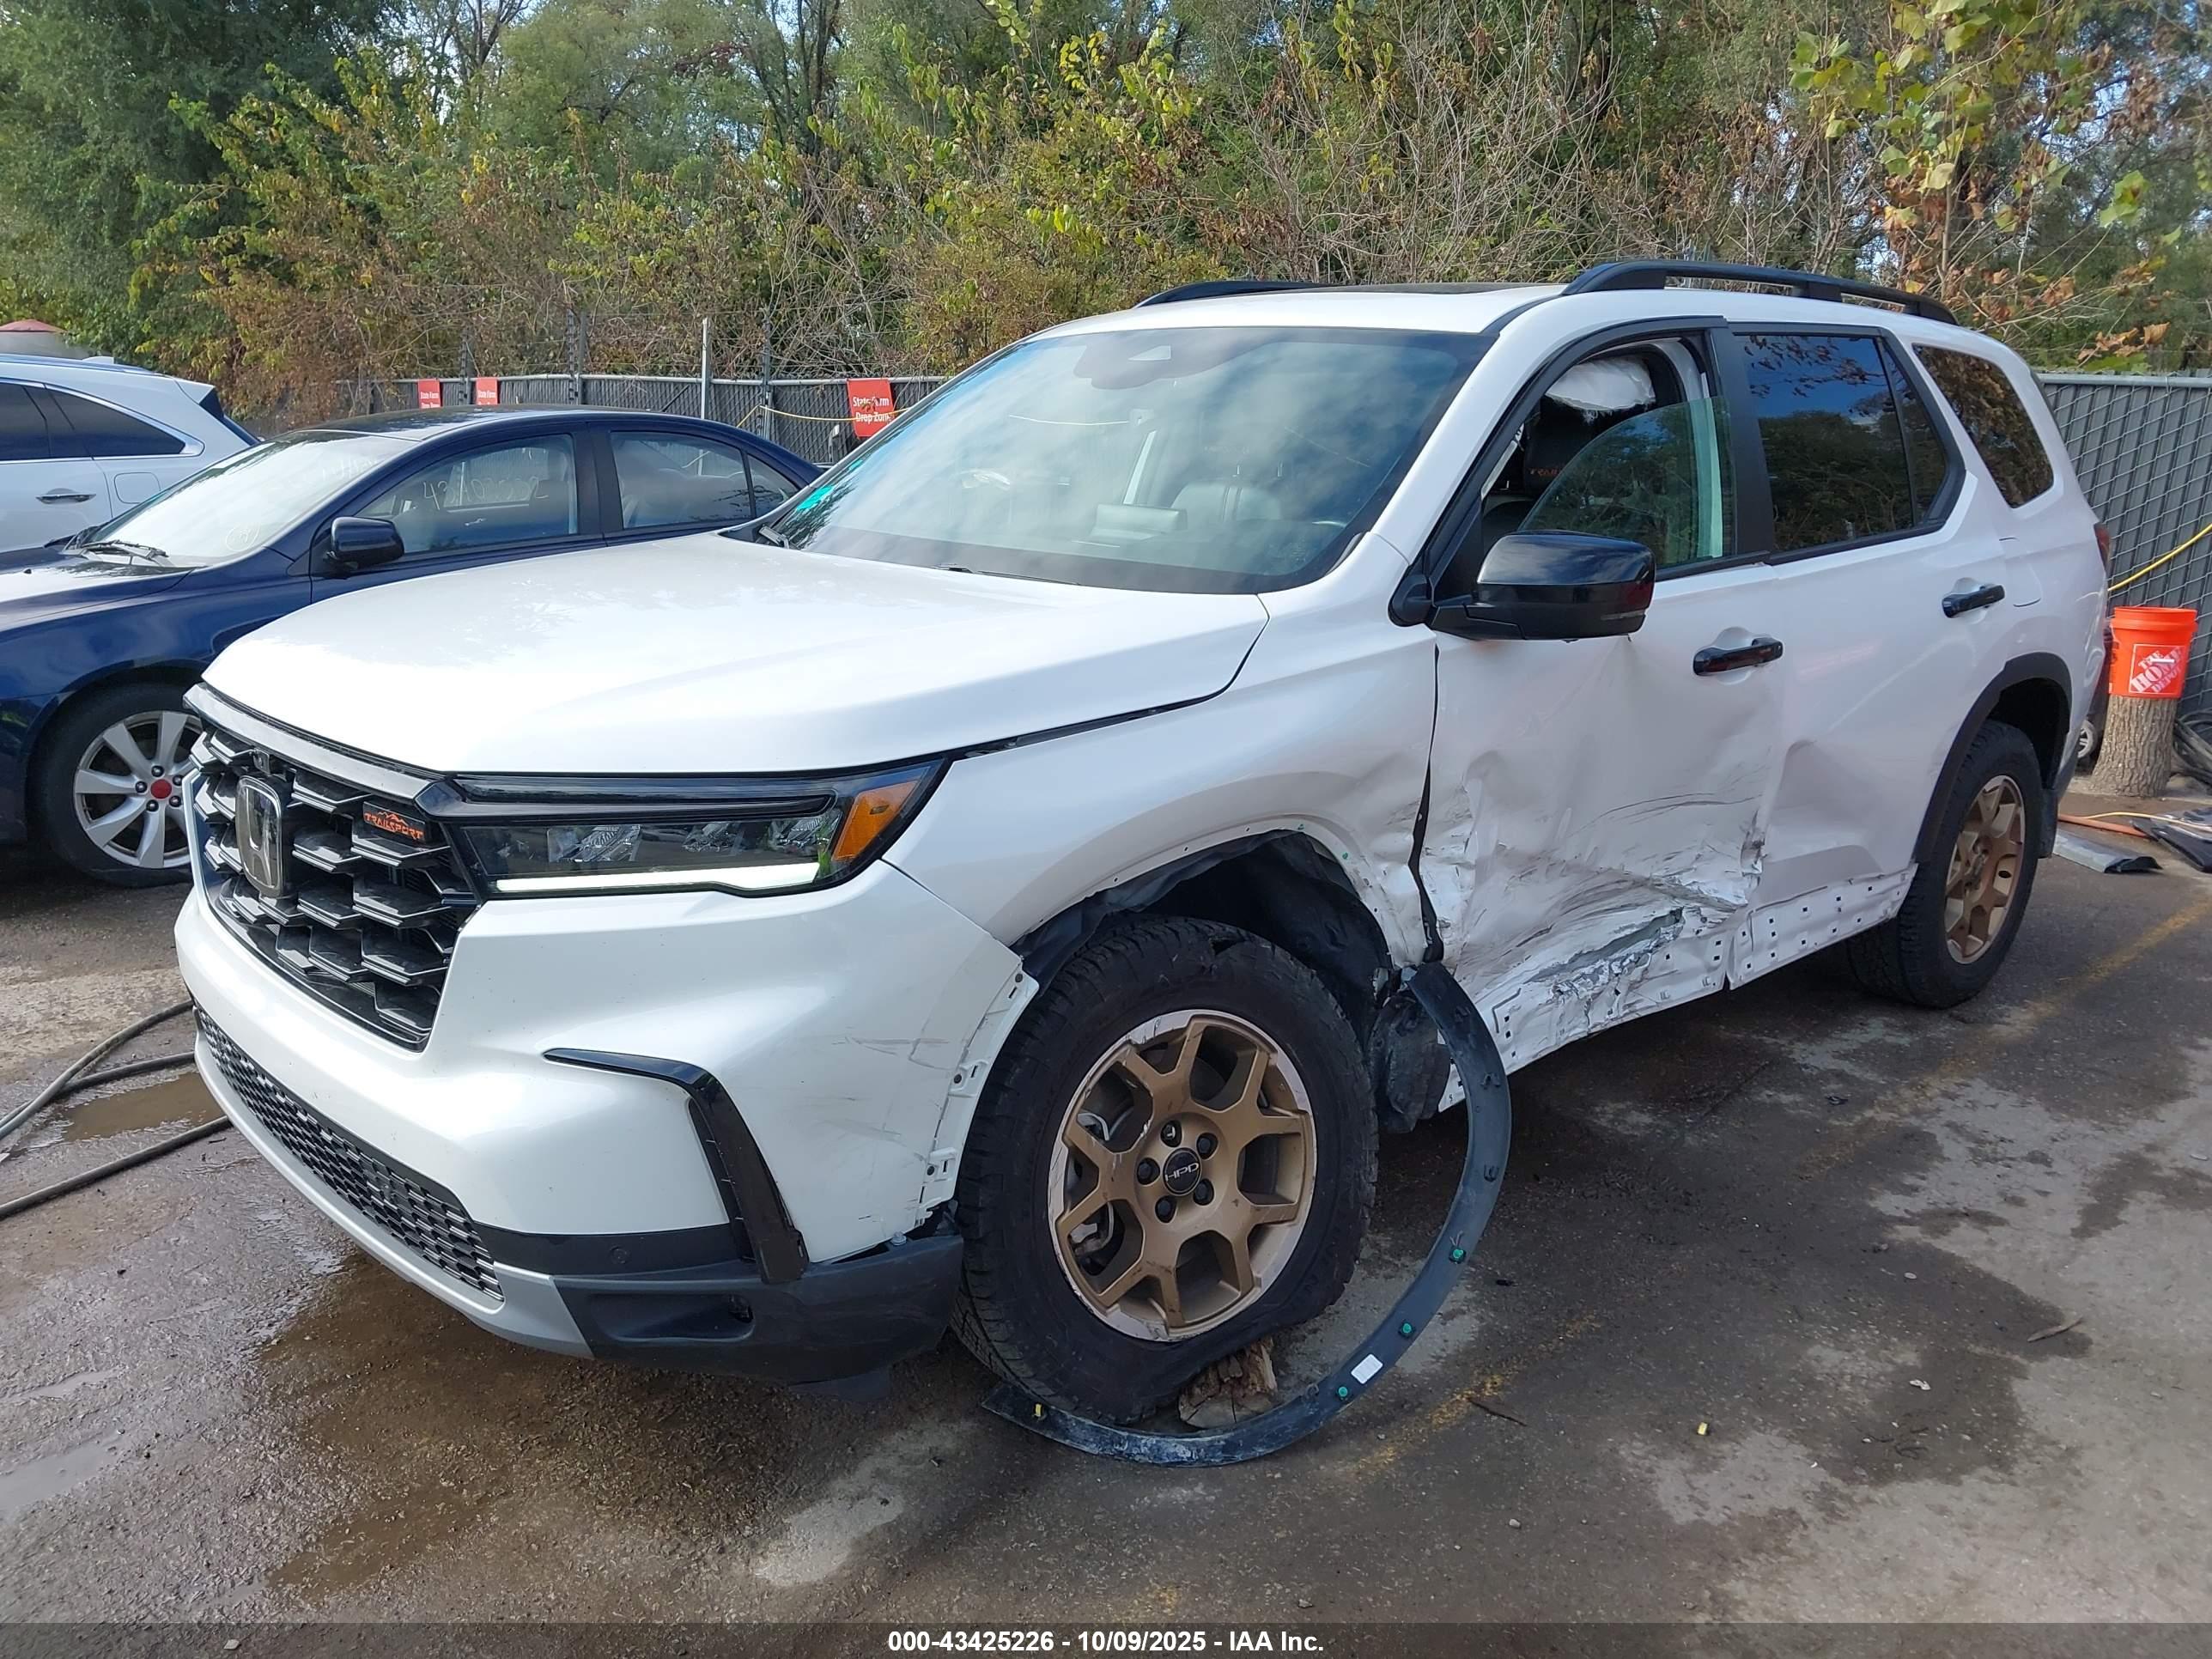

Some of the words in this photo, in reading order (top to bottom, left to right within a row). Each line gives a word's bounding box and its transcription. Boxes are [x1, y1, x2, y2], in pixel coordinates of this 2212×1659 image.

[855, 411, 872, 424] Drop
[365, 812, 423, 840] TRAILSPORT
[1164, 1162, 1200, 1182] HPD
